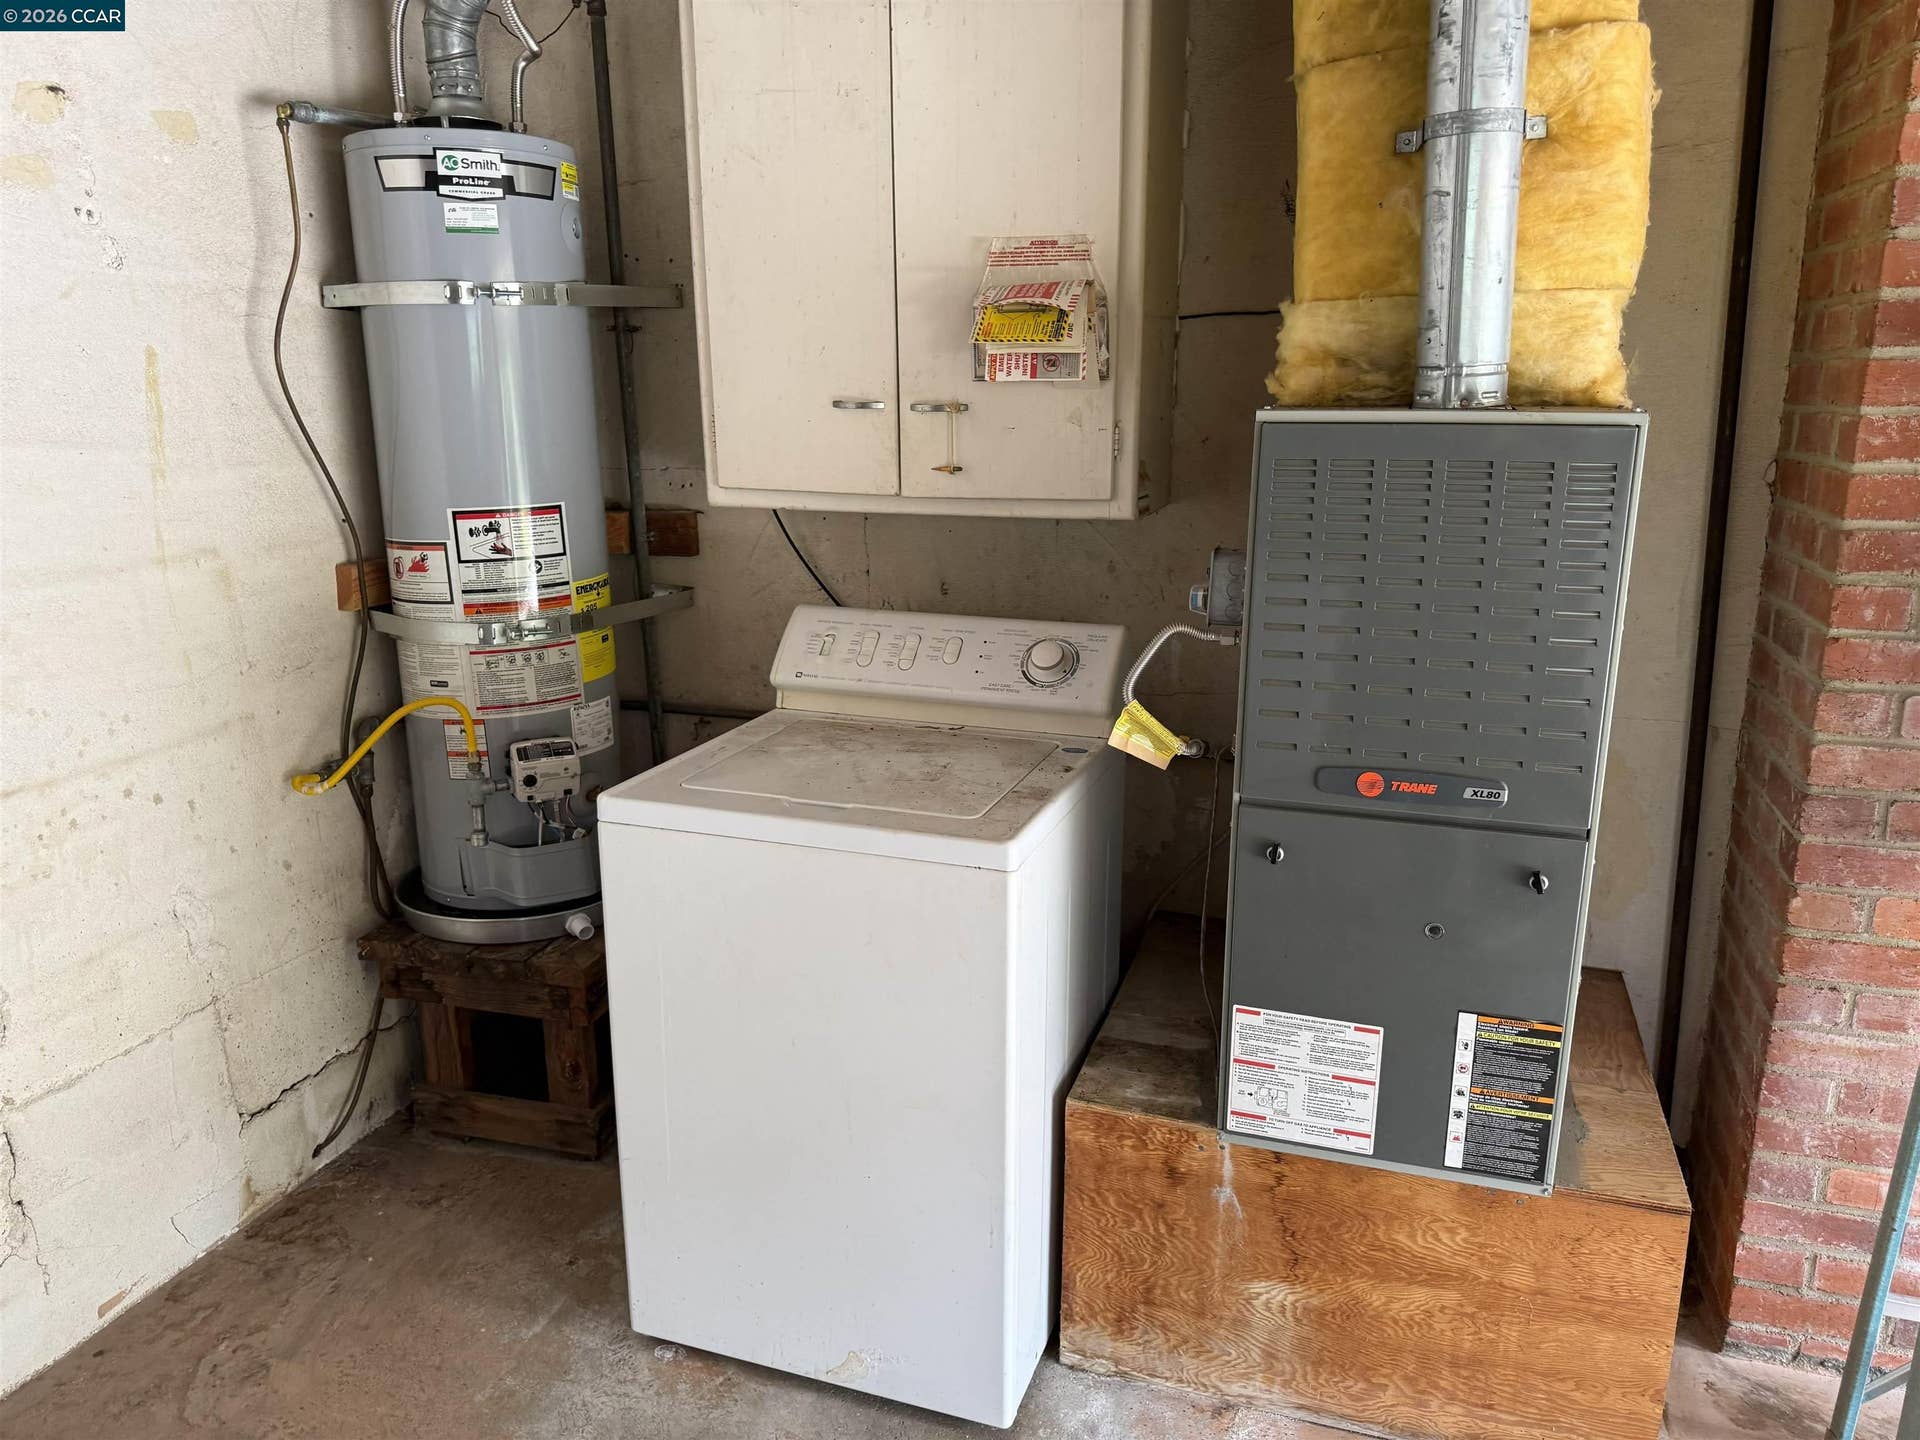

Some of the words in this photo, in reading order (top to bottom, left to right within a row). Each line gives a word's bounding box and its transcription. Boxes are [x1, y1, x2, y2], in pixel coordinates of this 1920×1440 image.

[452, 177, 489, 186] ProLine
[1391, 781, 1438, 794] TRANE
[1470, 789, 1501, 800] XL80
[1503, 1019, 1535, 1028] WARNING
[1486, 1090, 1539, 1101] AVERTISSEMENT
